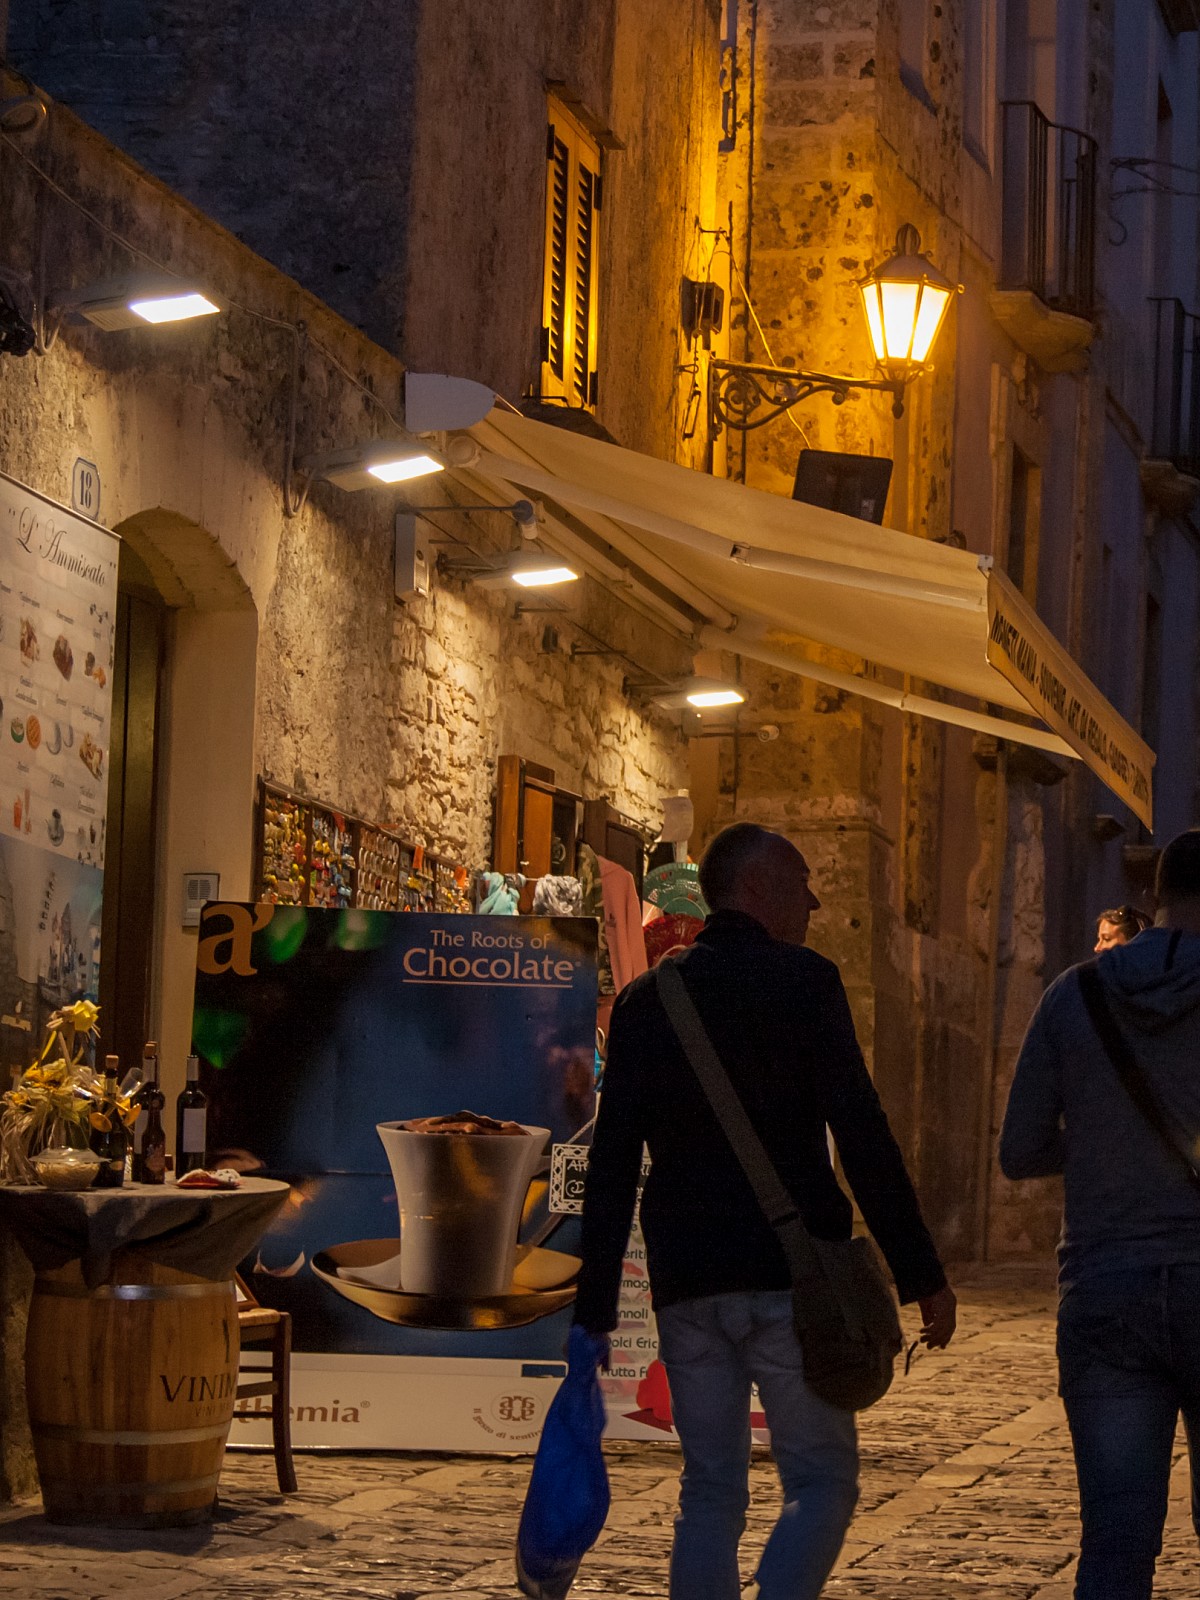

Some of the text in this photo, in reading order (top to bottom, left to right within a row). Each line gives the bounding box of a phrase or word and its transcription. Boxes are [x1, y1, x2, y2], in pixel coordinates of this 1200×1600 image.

[80, 470, 92, 509] 18
[430, 929, 553, 949] The Roots of
[402, 947, 575, 981] Chocolate
